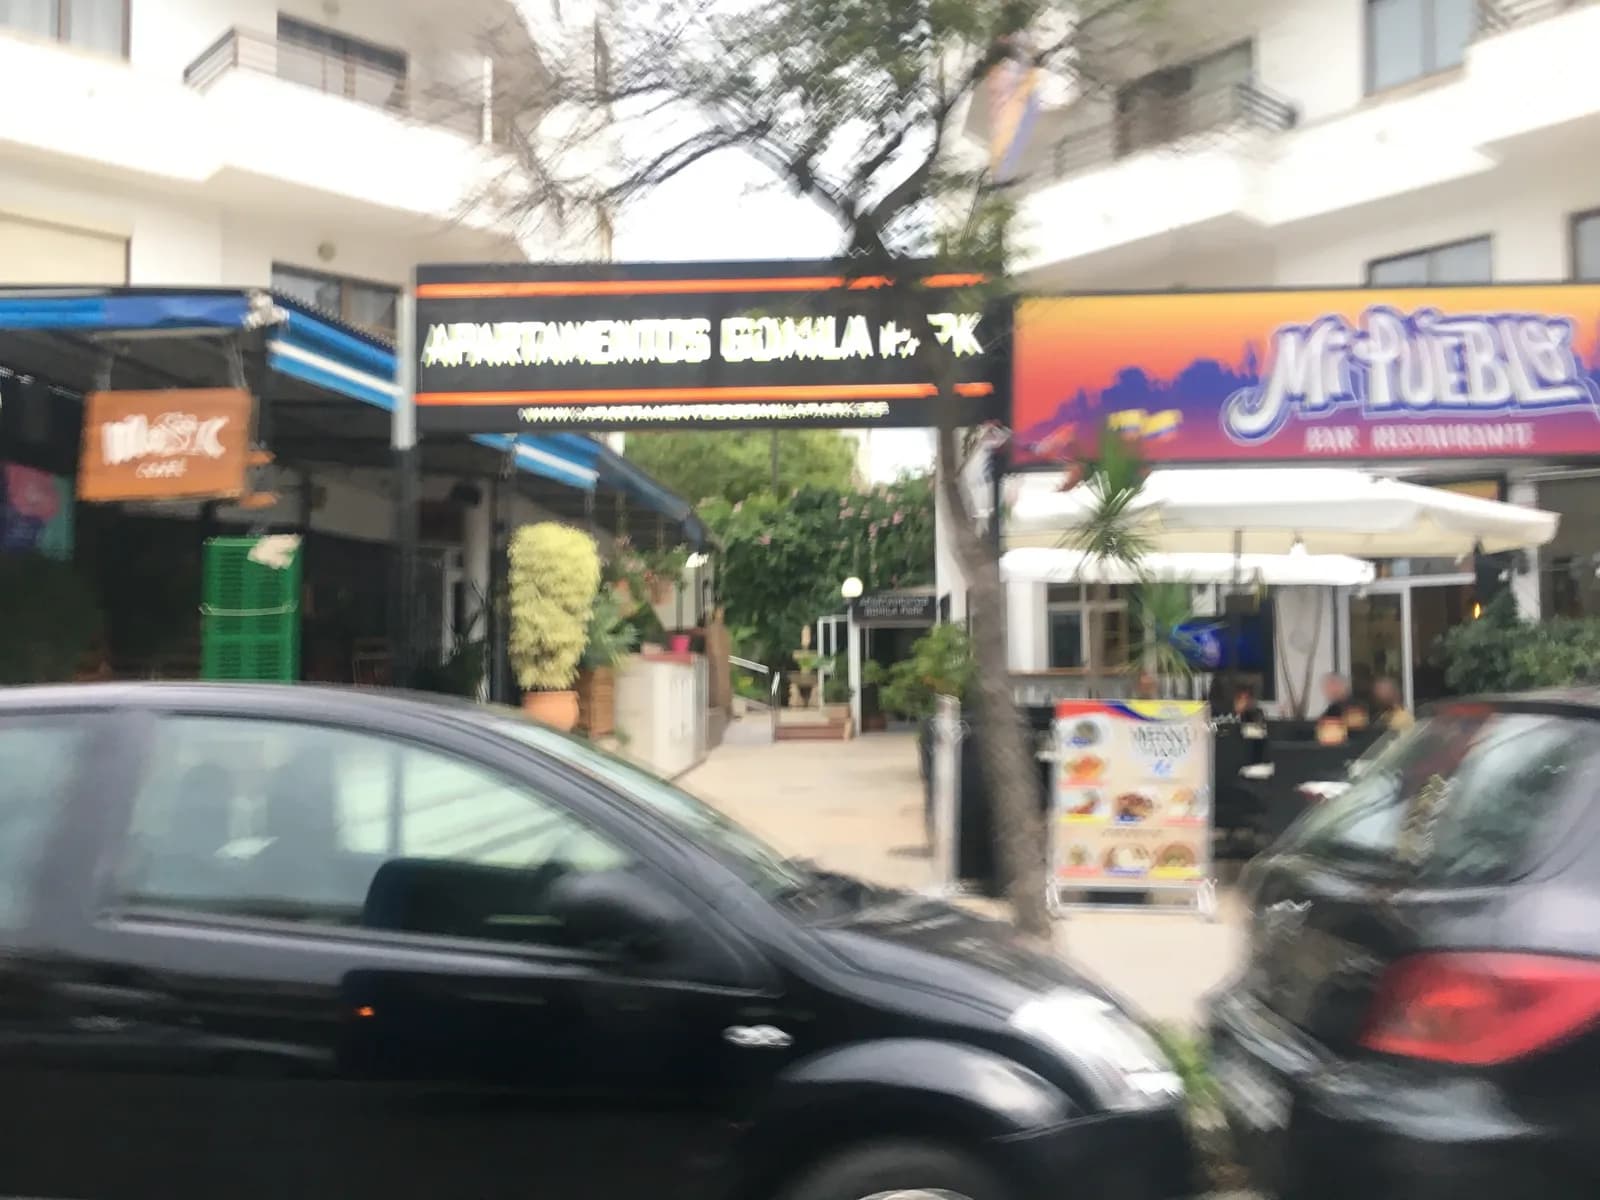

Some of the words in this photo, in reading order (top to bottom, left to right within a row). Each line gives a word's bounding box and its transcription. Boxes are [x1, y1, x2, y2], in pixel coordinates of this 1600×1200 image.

[421, 318, 711, 367] APARTAMENTOS
[720, 314, 874, 363] GOMILA
[1305, 425, 1359, 451] BAR
[1371, 422, 1536, 450] RESTAURANTE
